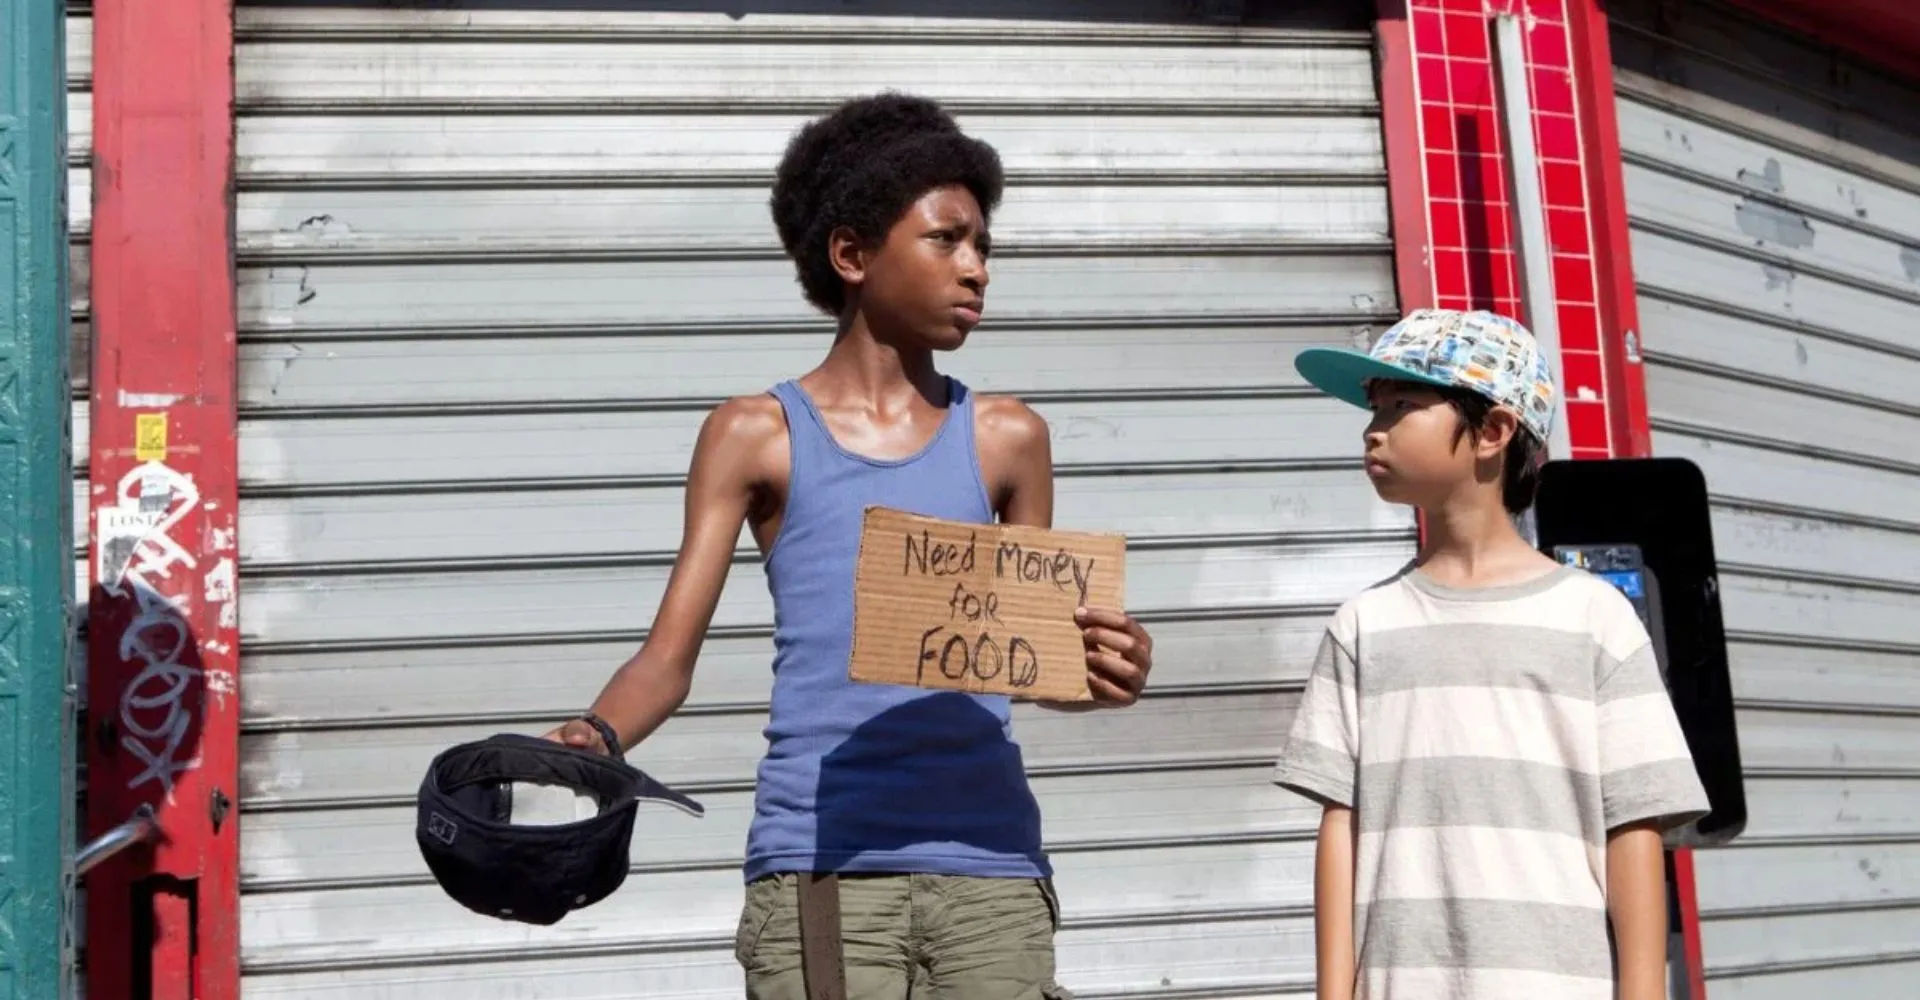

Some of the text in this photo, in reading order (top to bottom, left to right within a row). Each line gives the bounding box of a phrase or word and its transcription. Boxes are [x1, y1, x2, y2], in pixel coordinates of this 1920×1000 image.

[904, 529, 1094, 607] Need Money
[916, 625, 1038, 687] FOOD
